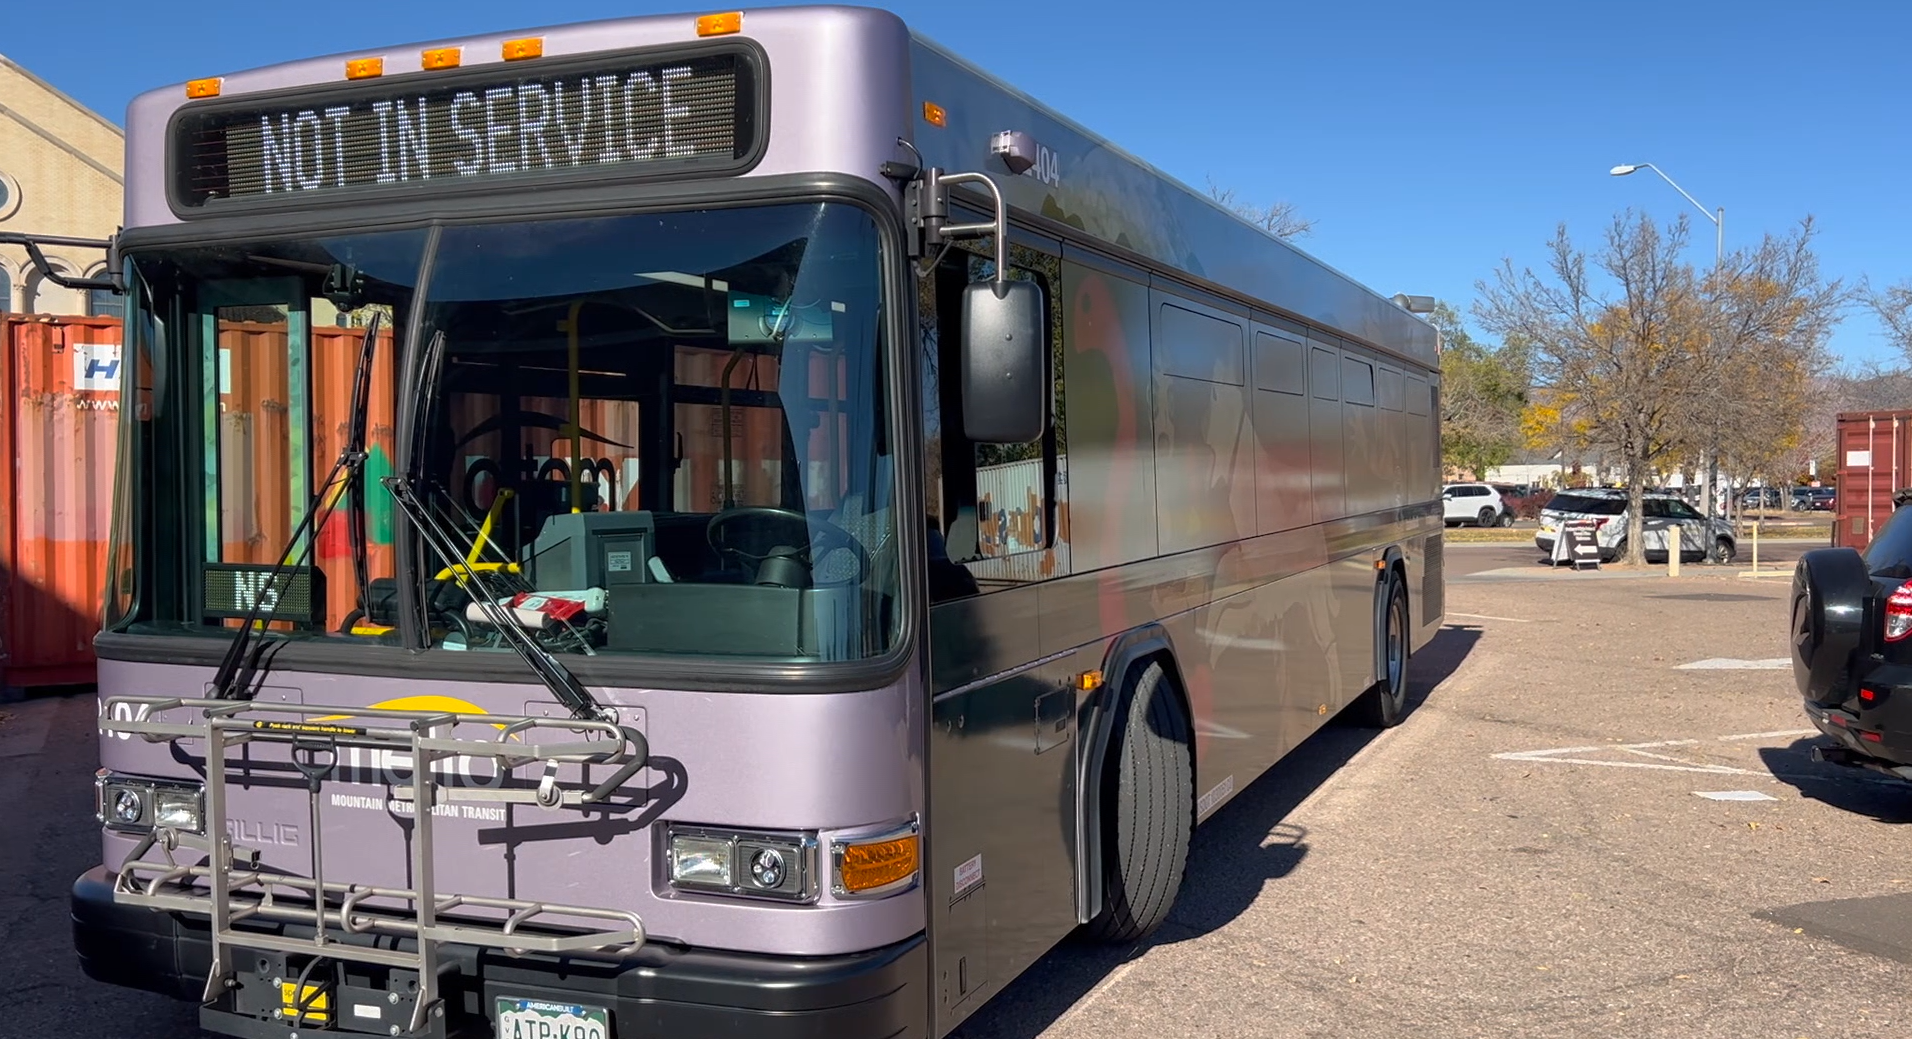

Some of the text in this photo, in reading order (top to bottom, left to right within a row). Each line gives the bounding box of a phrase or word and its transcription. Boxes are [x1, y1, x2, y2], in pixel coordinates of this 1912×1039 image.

[262, 66, 695, 194] NOT IN SERVICE
[1022, 143, 1060, 188] 404
[235, 571, 278, 611] NS
[331, 793, 506, 821] MOUNTAIN METRLITAN TRANSIT
